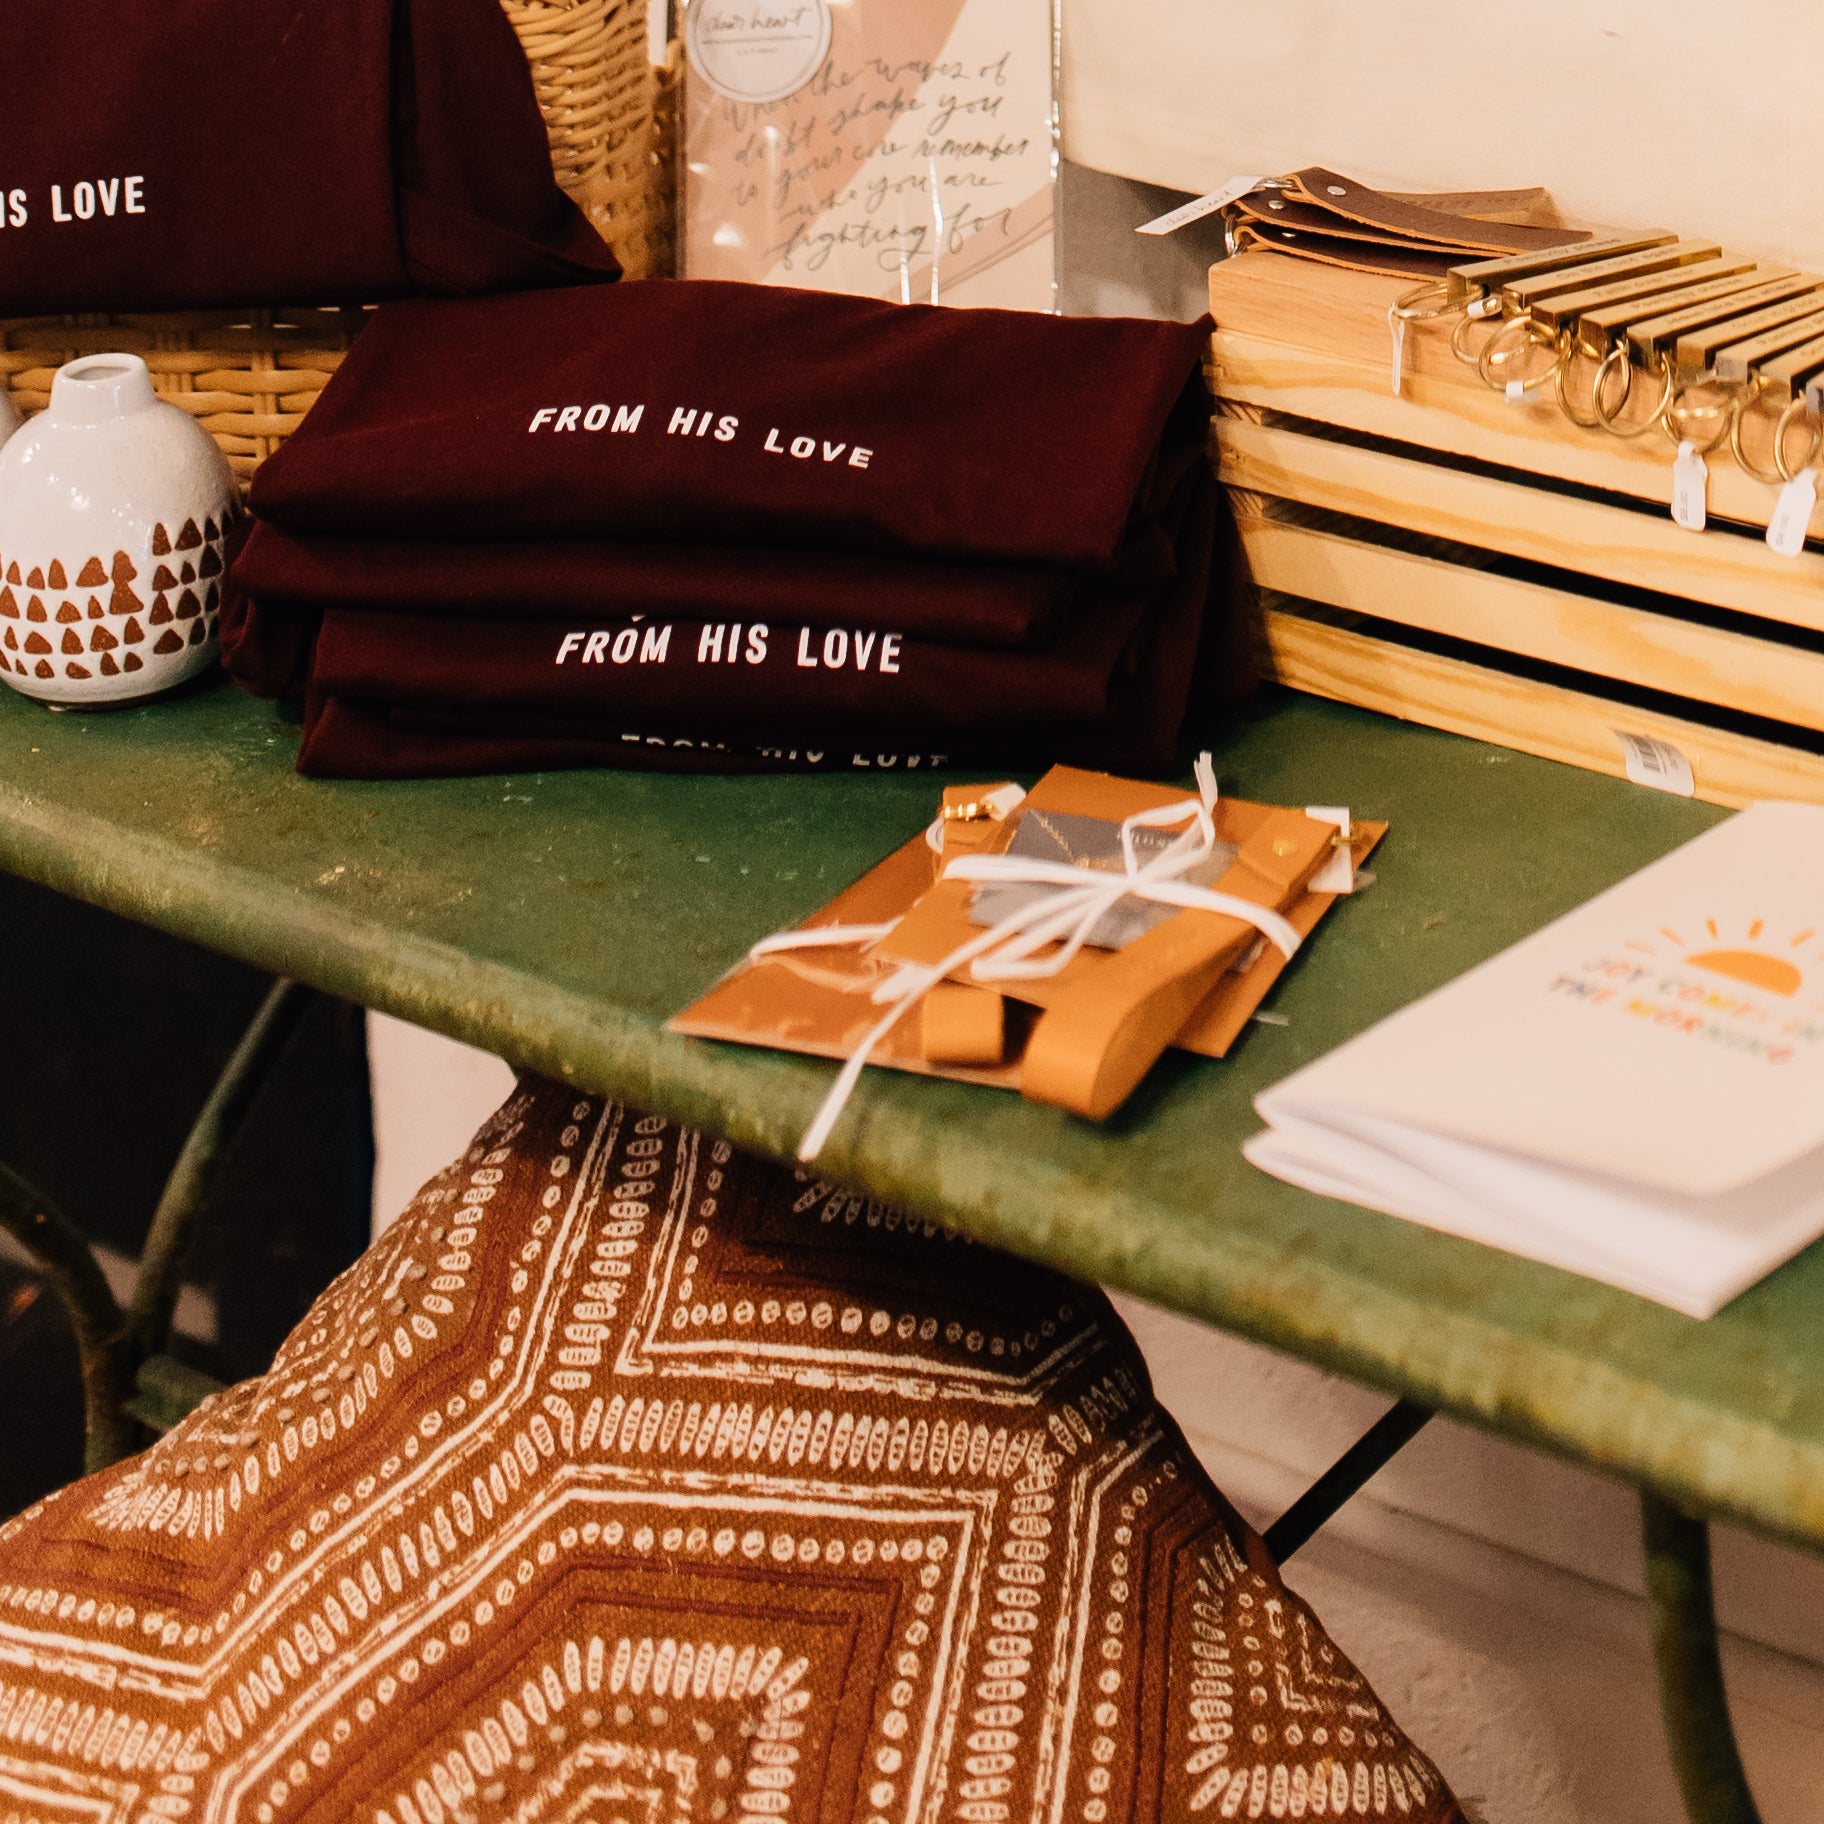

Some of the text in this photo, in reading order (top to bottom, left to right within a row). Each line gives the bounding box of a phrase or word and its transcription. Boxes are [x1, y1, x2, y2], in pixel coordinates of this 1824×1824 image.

[865, 57, 970, 85] waves
[978, 51, 1012, 87] of
[830, 88, 926, 135] shake
[926, 93, 1004, 136] you
[909, 137, 1031, 161] remember
[51, 175, 146, 223] LOVE
[866, 173, 928, 216] you
[943, 173, 1001, 189] are
[766, 202, 1012, 273] fighting for
[528, 403, 874, 470] FROM HIS LOVE
[555, 623, 904, 674] FROM HIS LOVE
